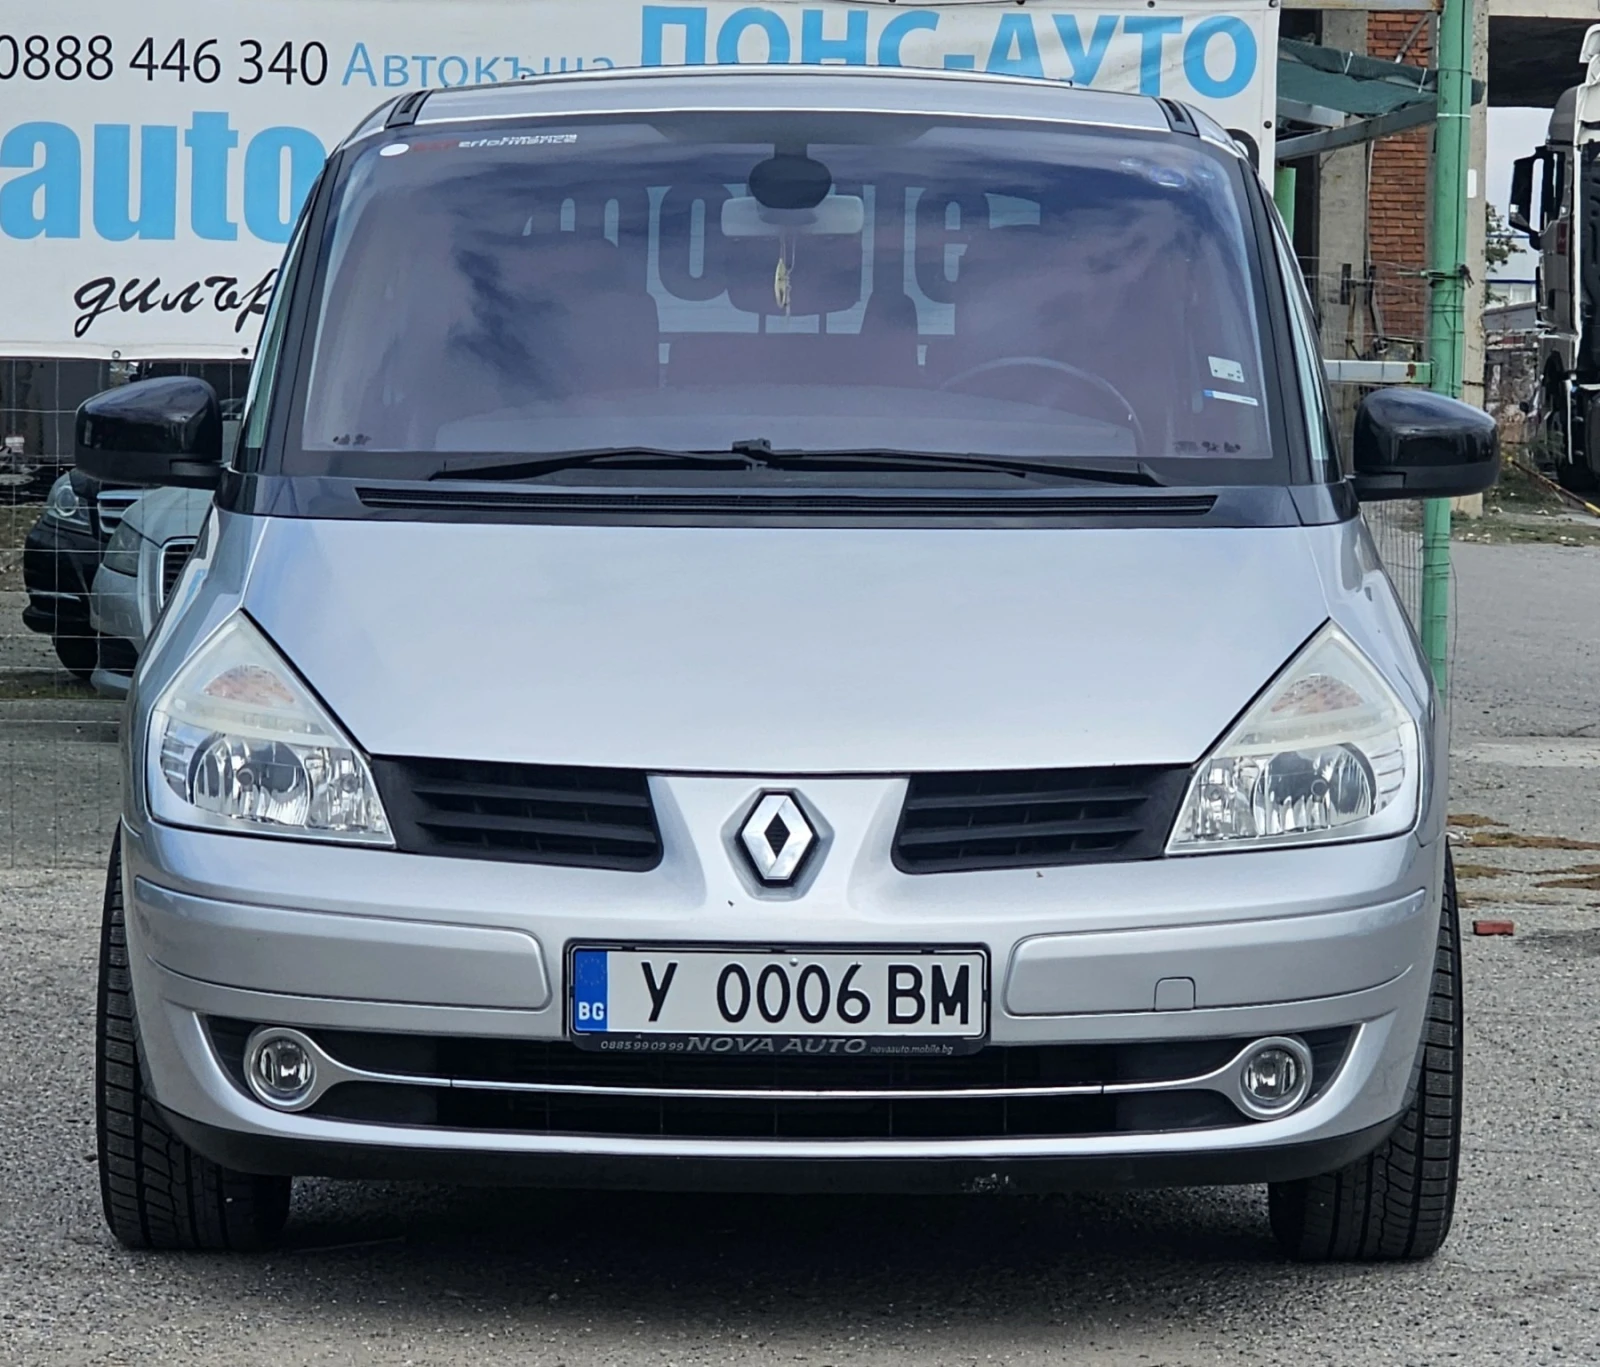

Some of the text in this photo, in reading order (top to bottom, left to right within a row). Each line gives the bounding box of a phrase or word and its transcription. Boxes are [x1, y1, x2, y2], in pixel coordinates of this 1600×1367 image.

[0, 35, 115, 80] 0888
[129, 37, 222, 84] 446
[237, 40, 329, 86] 340
[641, 5, 1257, 99] ПОНС-АУТО
[0, 111, 327, 244] auto
[579, 1001, 605, 1020] BG
[716, 963, 872, 1024] 0006
[686, 1036, 775, 1052] NOVA
[780, 1037, 868, 1053] AUTO
